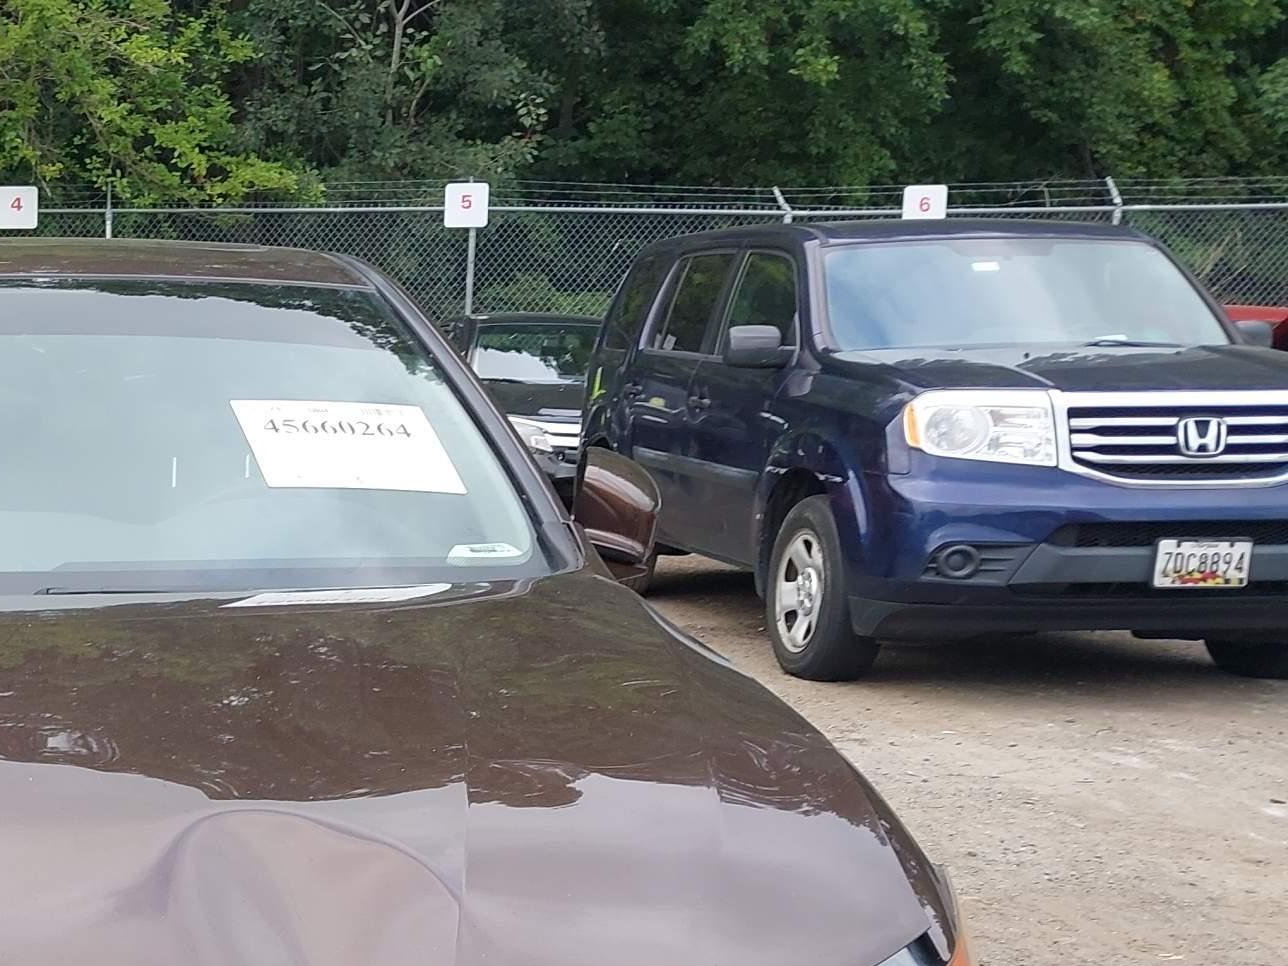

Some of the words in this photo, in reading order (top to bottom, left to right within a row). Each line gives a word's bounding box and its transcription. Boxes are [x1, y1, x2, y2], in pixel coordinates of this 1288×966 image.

[10, 196, 24, 212] 4
[460, 194, 473, 210] 5
[918, 196, 932, 212] 6
[263, 418, 412, 438] 45660264
